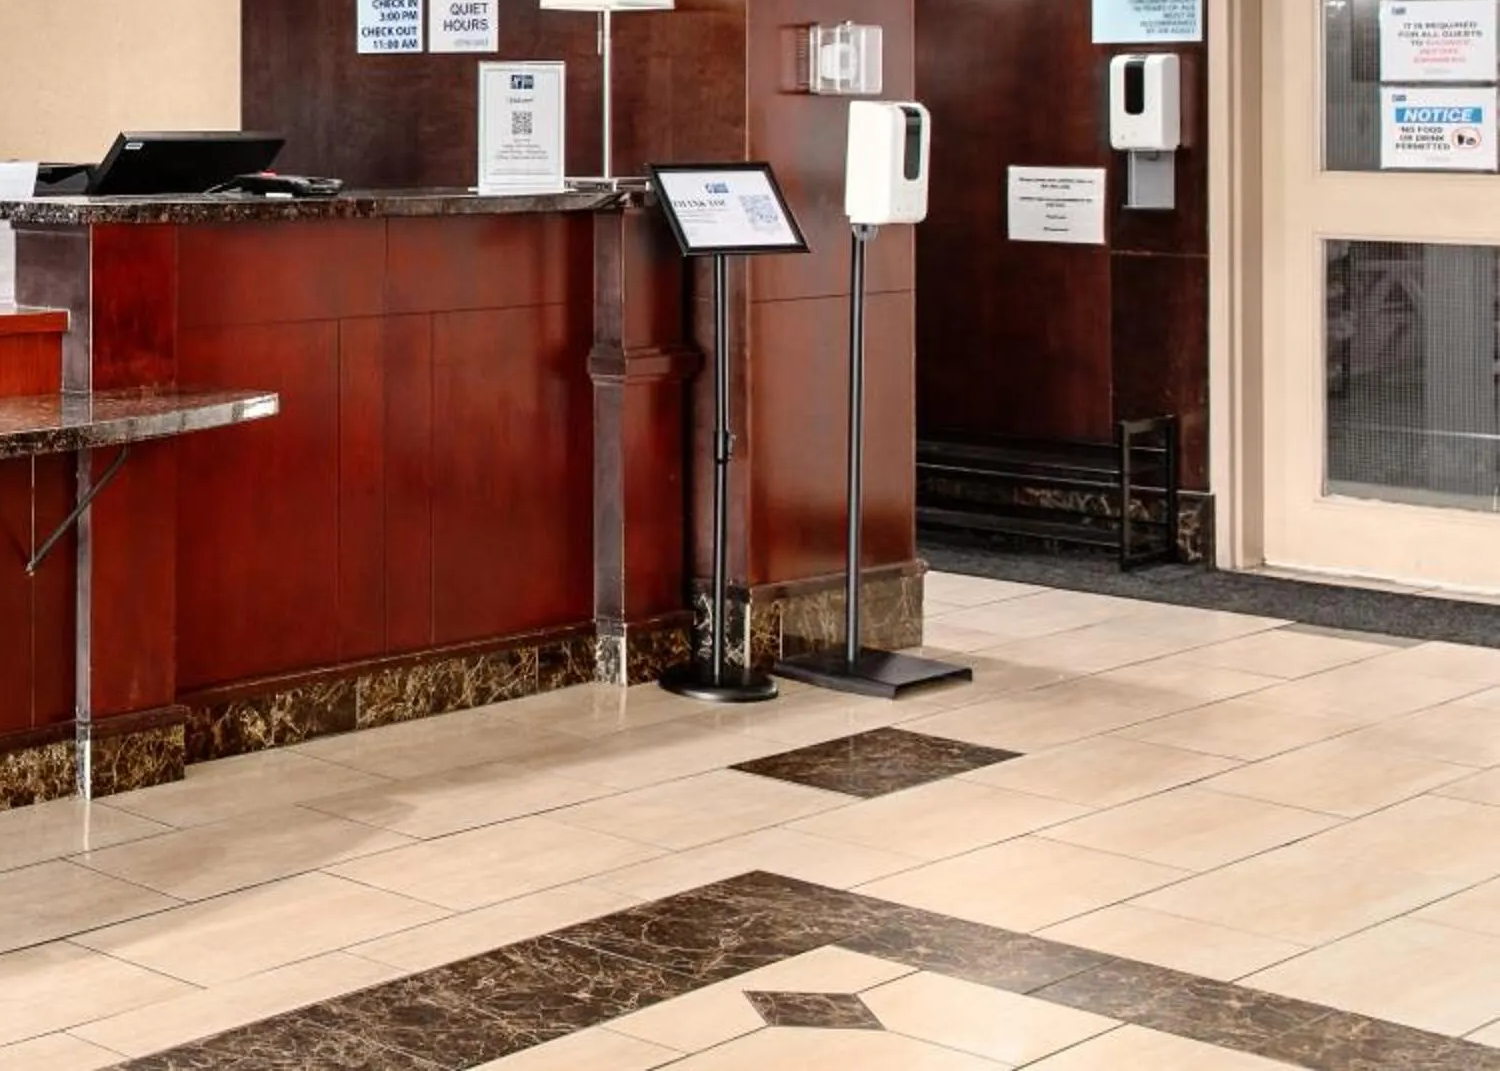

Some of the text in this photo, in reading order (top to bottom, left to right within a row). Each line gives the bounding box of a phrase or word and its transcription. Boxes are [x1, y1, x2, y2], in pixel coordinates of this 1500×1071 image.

[402, 10, 418, 20] PM
[449, 2, 489, 16] QUIET
[443, 18, 489, 32] HOURS
[362, 27, 417, 38] CHECK OUT
[402, 40, 418, 49] AM
[1403, 108, 1475, 122] NOTICE
